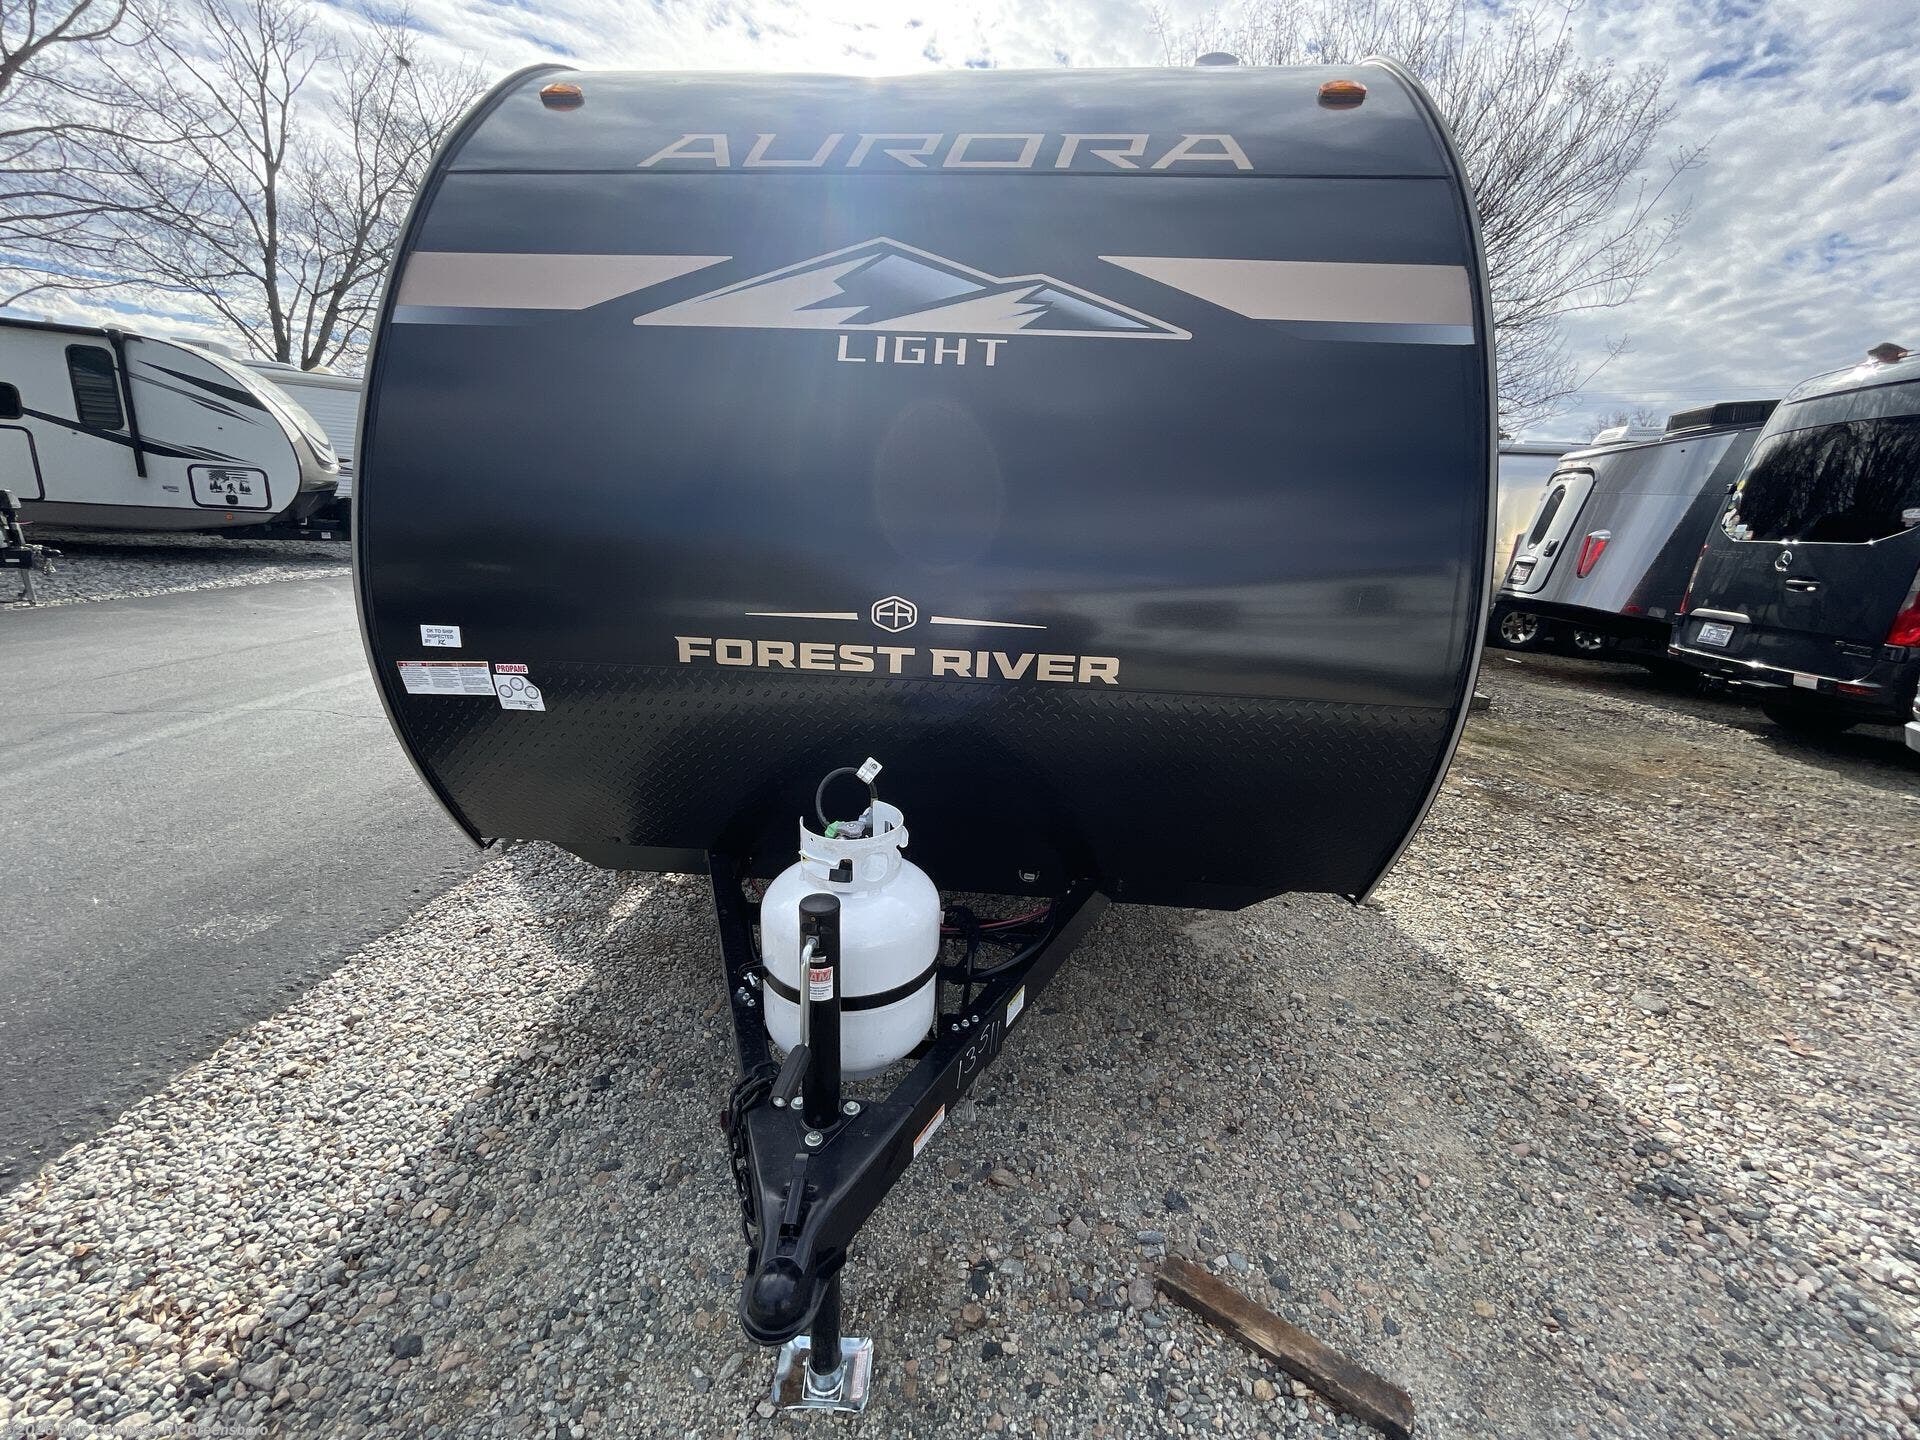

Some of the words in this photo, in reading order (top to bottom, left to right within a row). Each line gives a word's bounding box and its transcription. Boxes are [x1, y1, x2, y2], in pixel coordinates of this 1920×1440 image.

[637, 132, 1255, 170] AURORA
[836, 334, 1008, 367] LIGHT
[496, 664, 527, 673] PROPANE
[674, 635, 916, 674] FOREST
[929, 647, 1121, 685] RIVER
